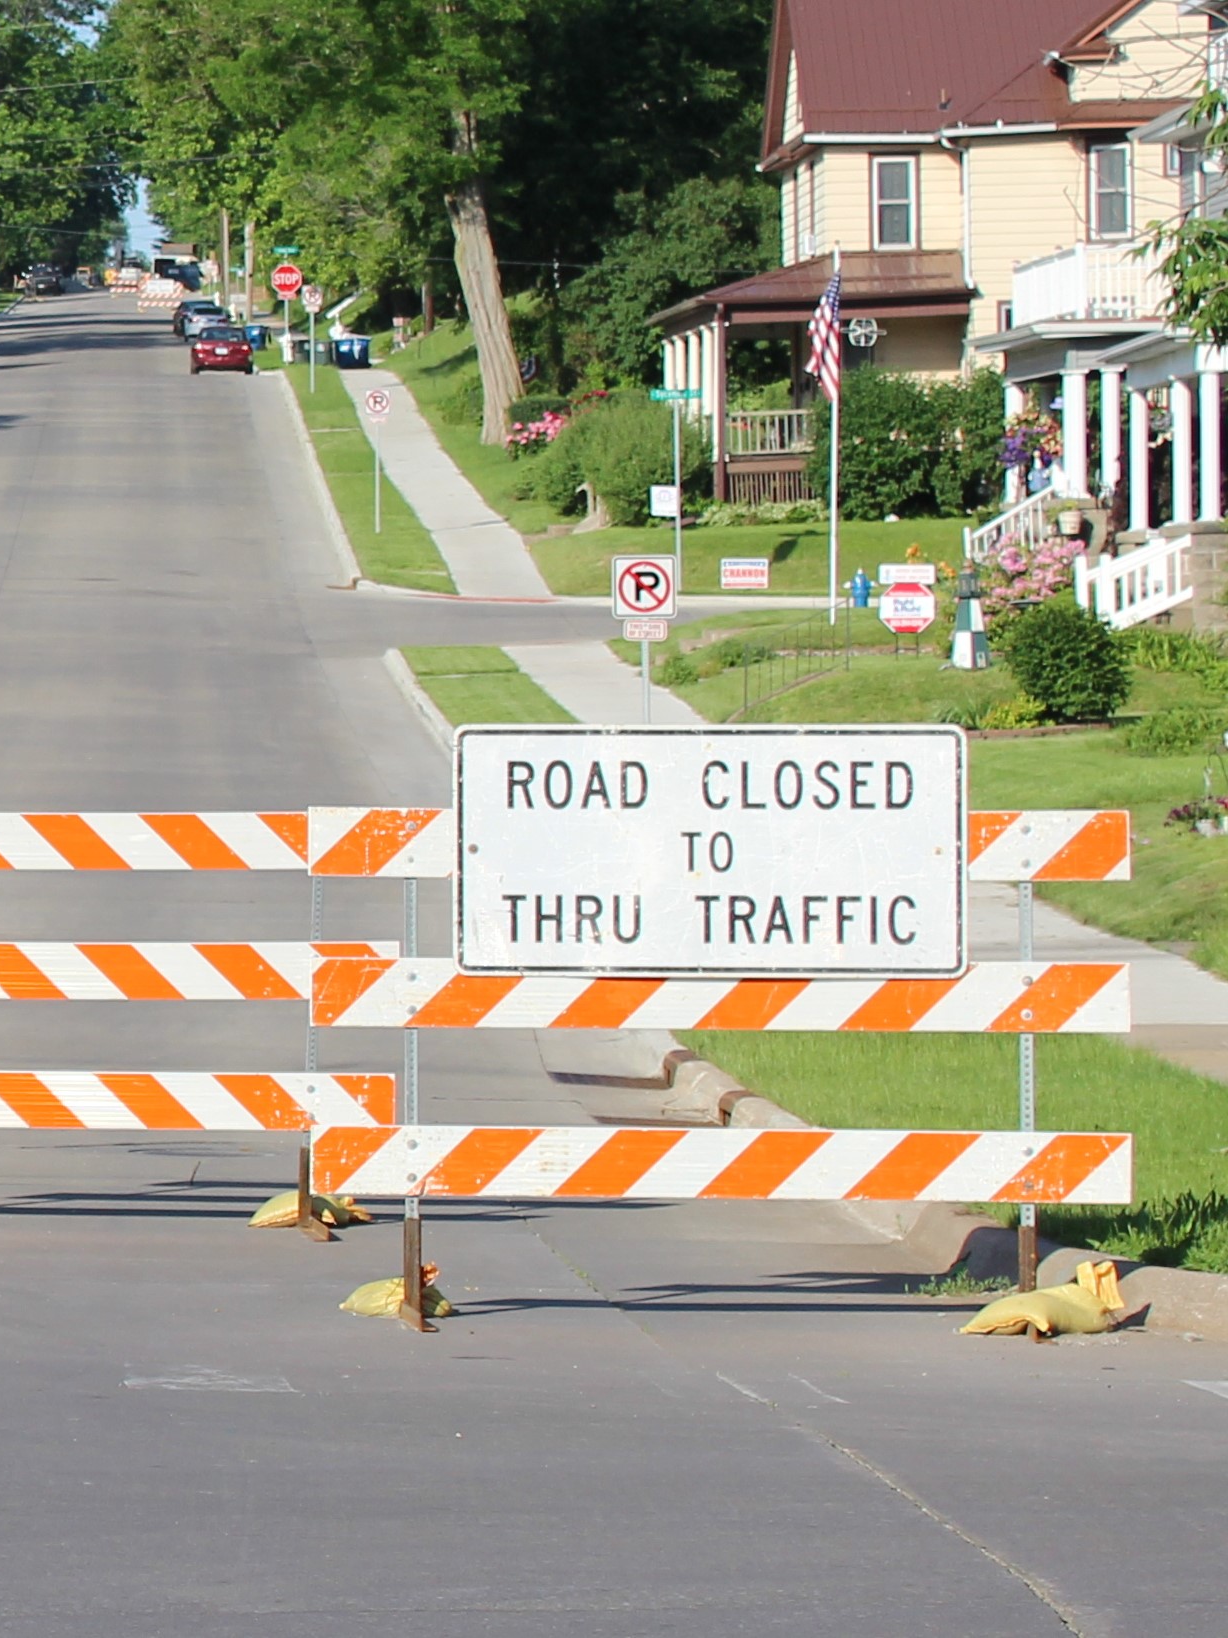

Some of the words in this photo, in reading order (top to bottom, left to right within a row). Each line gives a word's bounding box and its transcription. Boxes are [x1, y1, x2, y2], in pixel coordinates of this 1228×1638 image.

[274, 273, 299, 286] STOP
[635, 572, 660, 602] P
[507, 760, 648, 810] ROAD
[702, 760, 914, 810] CLOSED
[681, 831, 734, 873] TO
[502, 894, 641, 944] THRU
[696, 894, 917, 945] TRAFFIC
